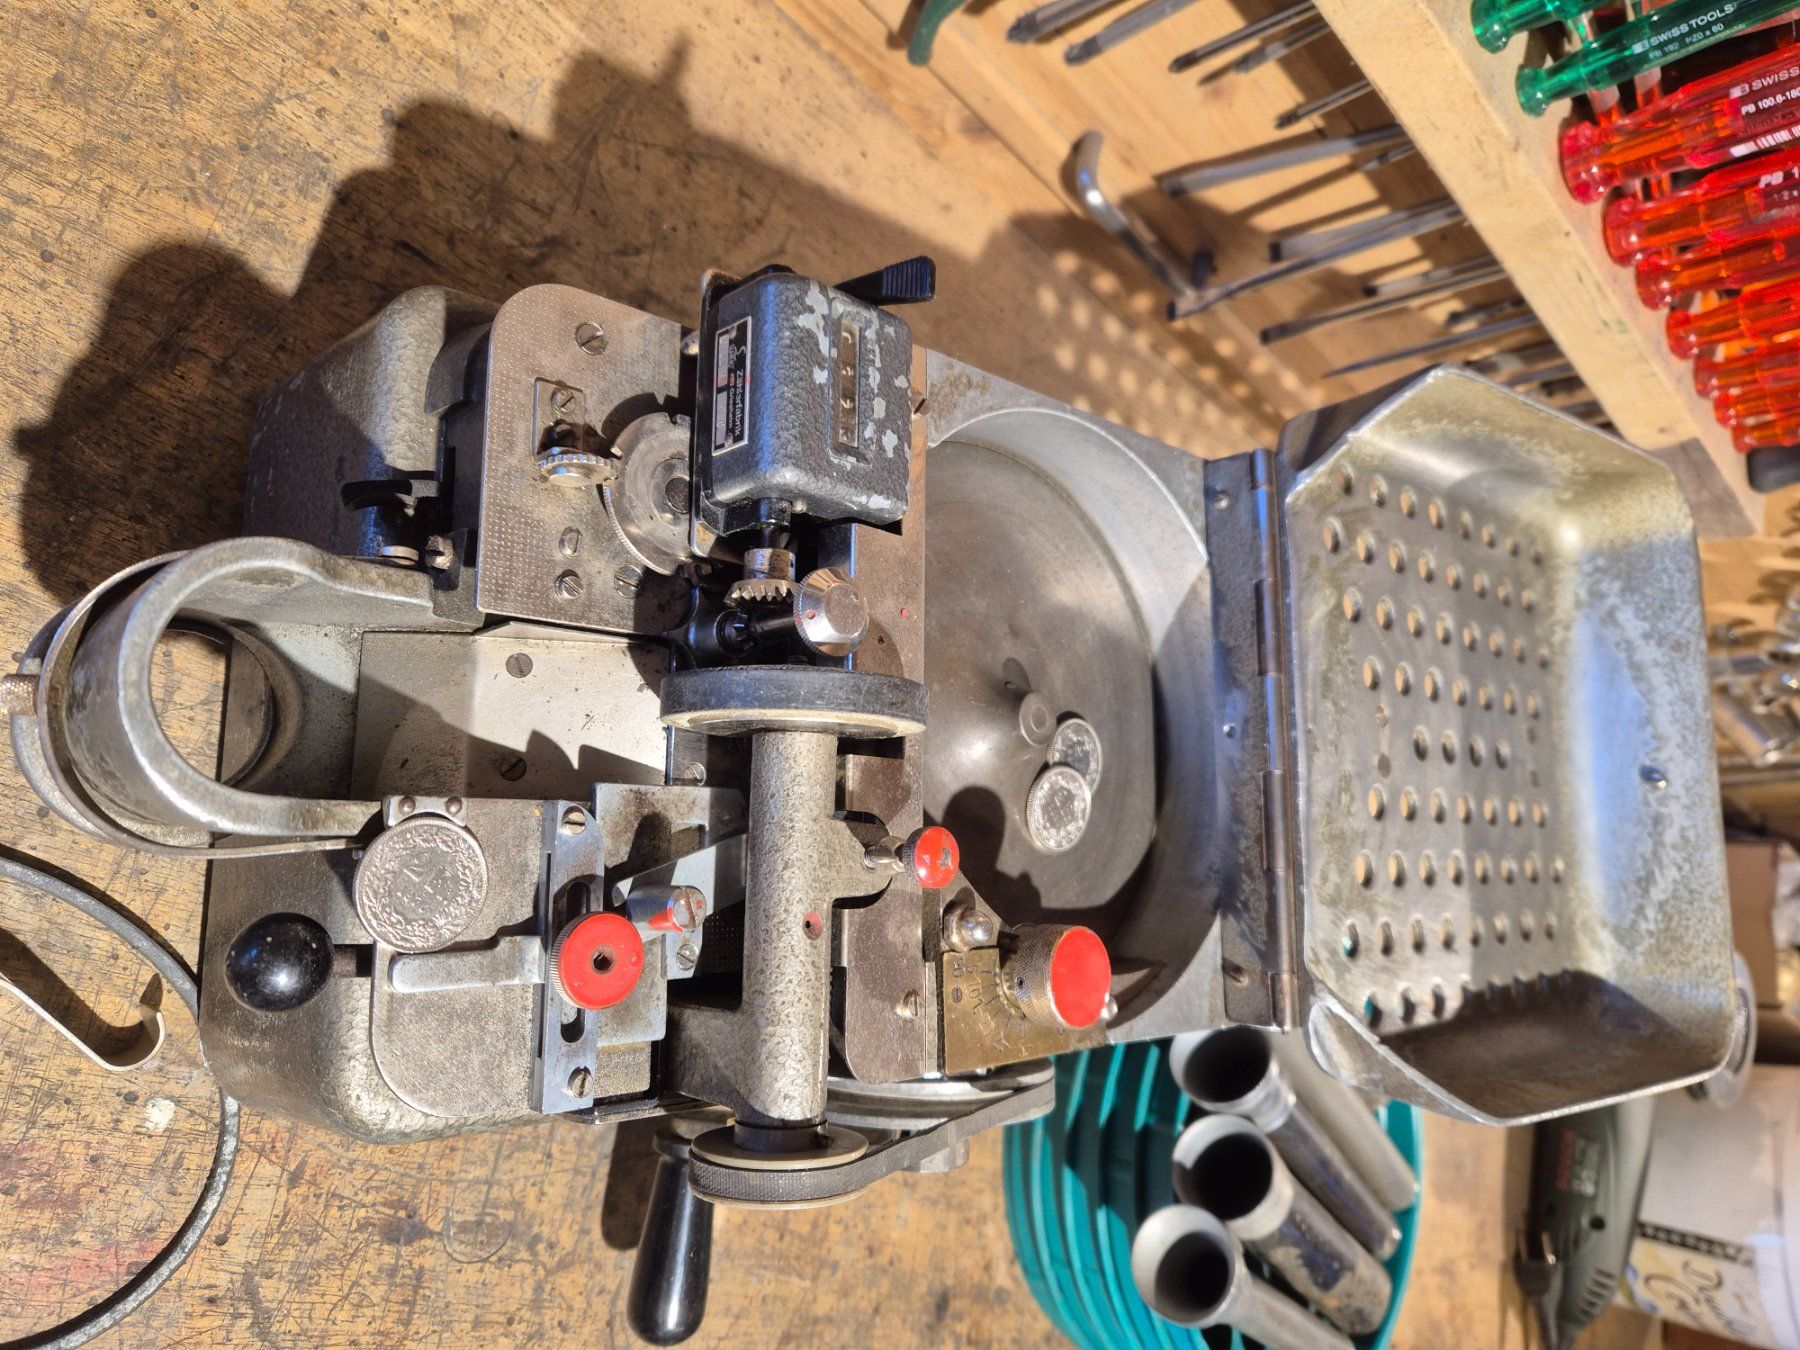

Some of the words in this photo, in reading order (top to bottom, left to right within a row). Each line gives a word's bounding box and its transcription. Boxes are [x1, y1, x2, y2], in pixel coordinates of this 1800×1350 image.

[1650, 23, 1689, 46] SWISS
[1688, 4, 1734, 28] TOOLS
[1711, 23, 1724, 33] 60
[1751, 67, 1800, 90] SWISS
[1741, 103, 1756, 116] PB
